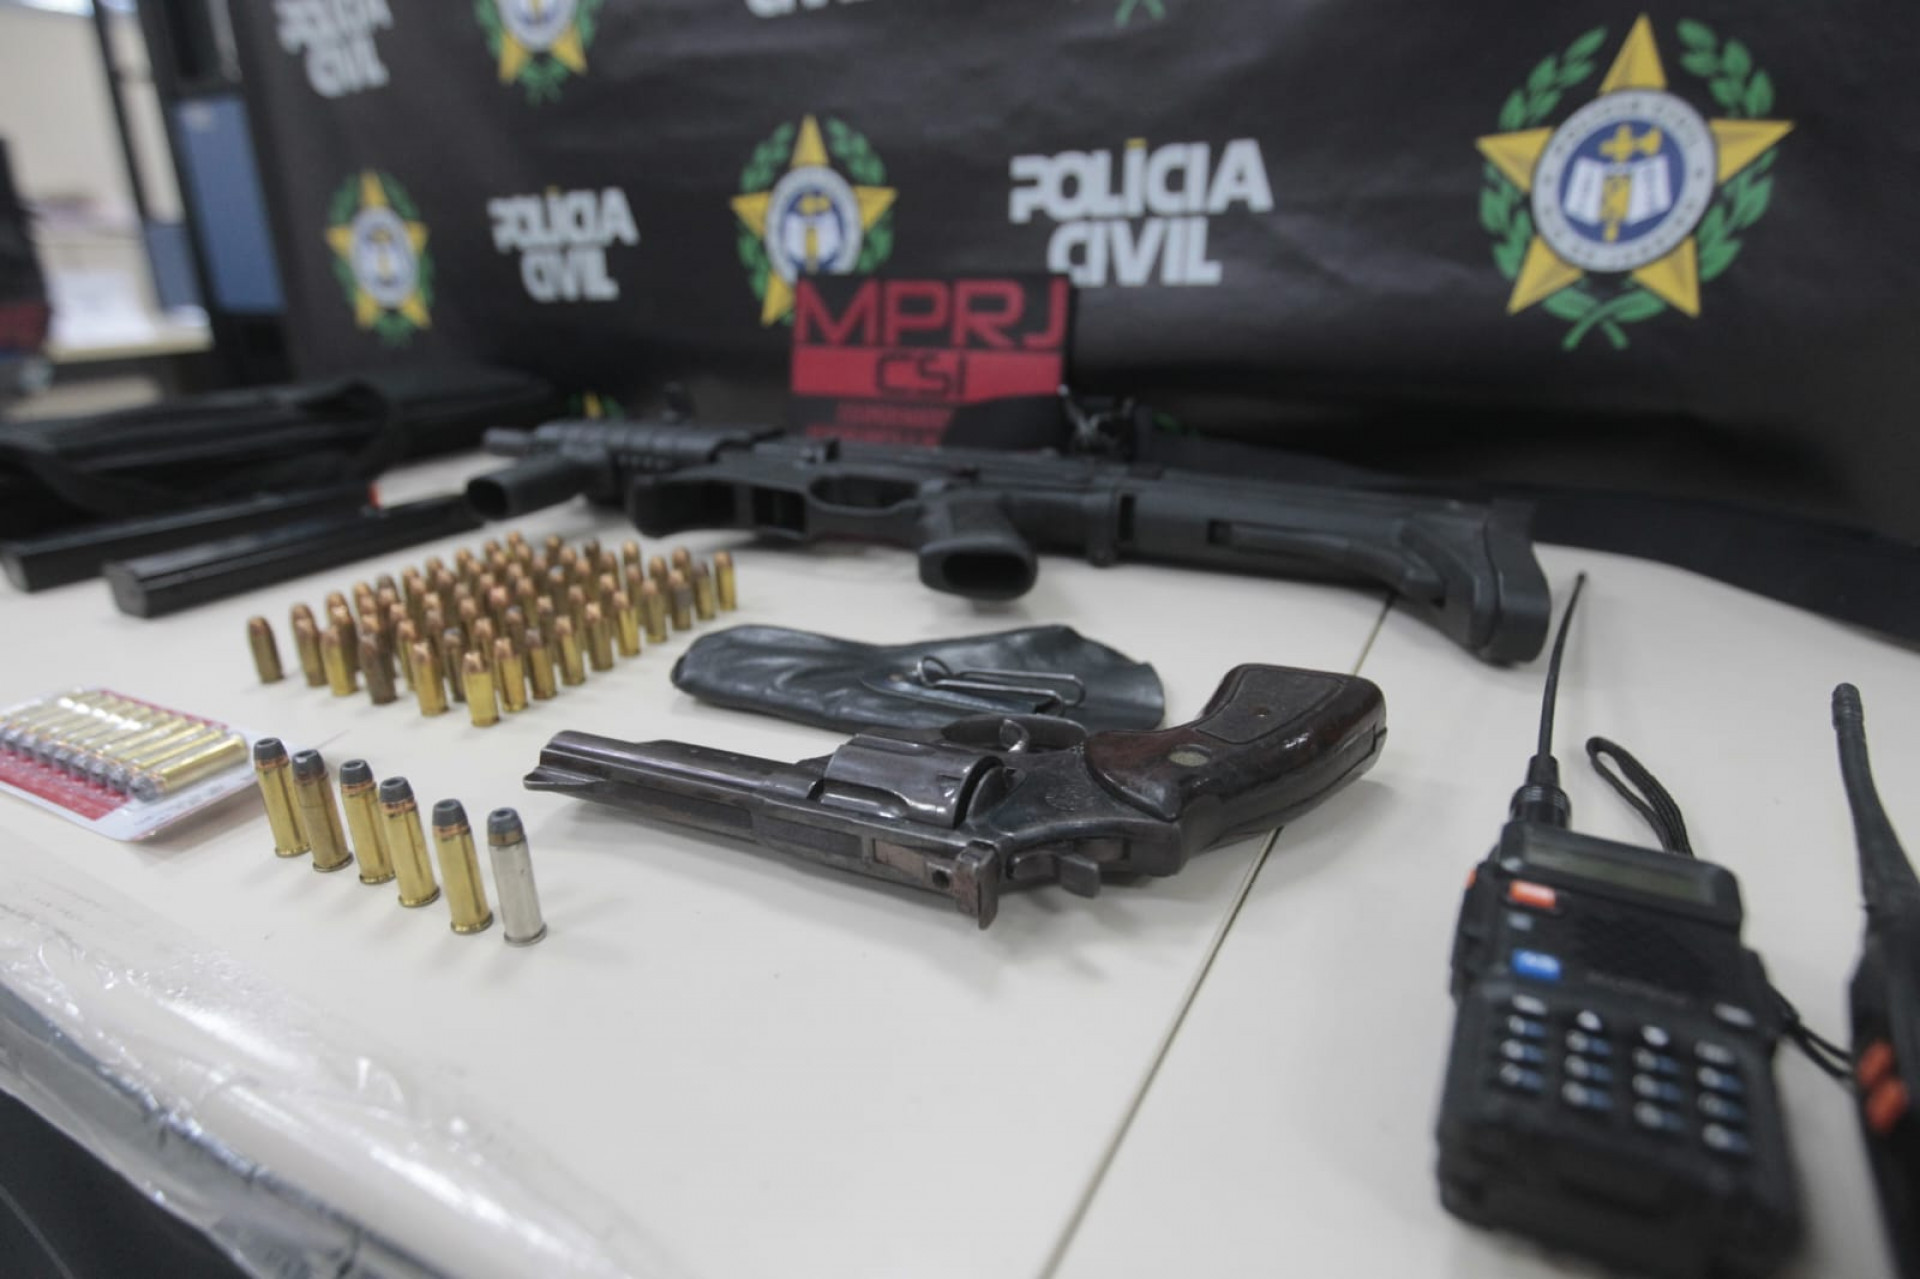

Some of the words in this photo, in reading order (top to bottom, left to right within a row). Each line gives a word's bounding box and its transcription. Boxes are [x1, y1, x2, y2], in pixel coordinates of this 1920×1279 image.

[1009, 138, 1273, 222] POLÍCIA
[488, 184, 640, 253] POLÍCIA
[1048, 216, 1223, 286] CIVIL
[520, 247, 621, 302] CIVIL
[793, 277, 1070, 349] MPRJ
[877, 353, 967, 399] CSI
